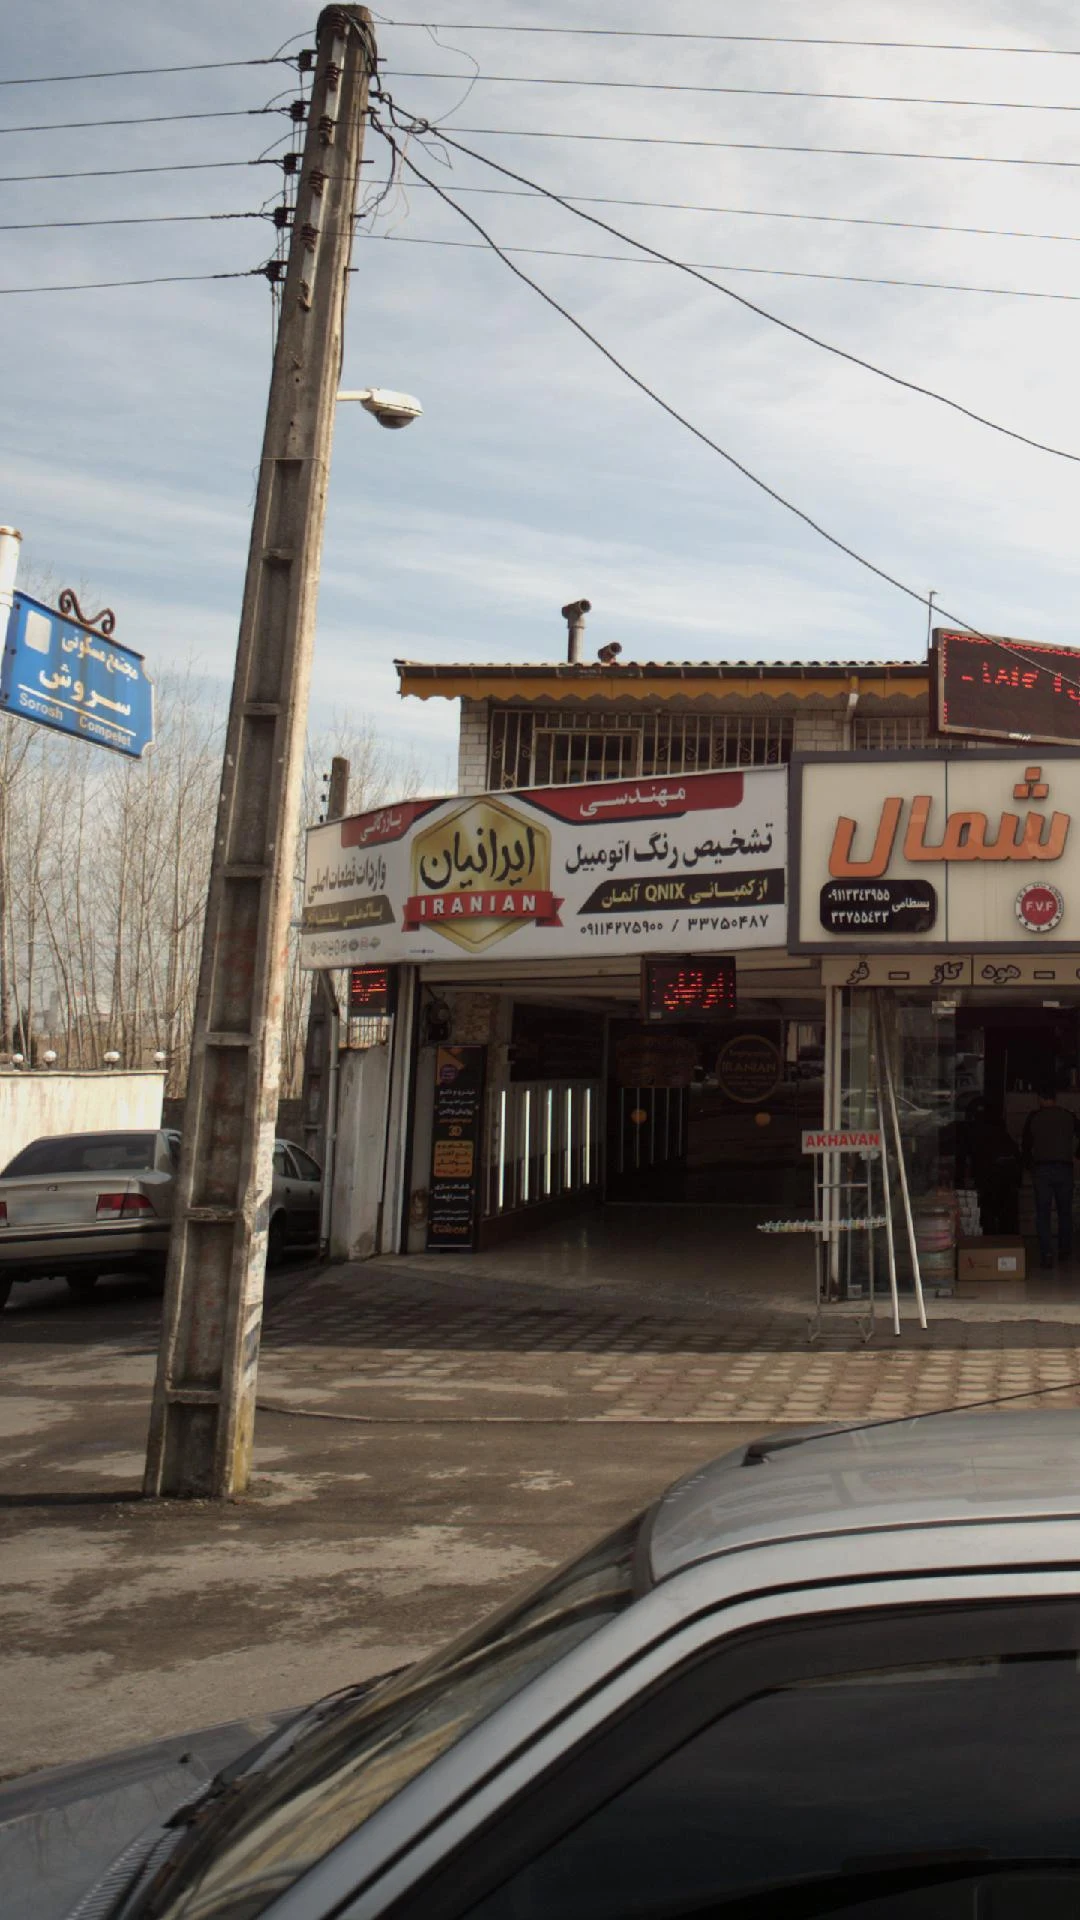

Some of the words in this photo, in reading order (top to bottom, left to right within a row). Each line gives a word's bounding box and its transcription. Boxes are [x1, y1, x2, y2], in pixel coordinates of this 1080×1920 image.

[18, 692, 63, 721] Sorosh
[39, 663, 131, 717] سروش
[579, 784, 686, 817] مهندسی
[828, 766, 1071, 878] شمال
[419, 826, 536, 890] ایرانیان
[565, 839, 630, 875] اتومبیل
[633, 831, 679, 869] رنگ
[682, 823, 773, 868] تشخیص
[419, 894, 537, 917] IRANIAN
[600, 883, 639, 909] آلمان
[644, 882, 686, 903] QNIX
[805, 1133, 881, 1148] AKHAVAN
